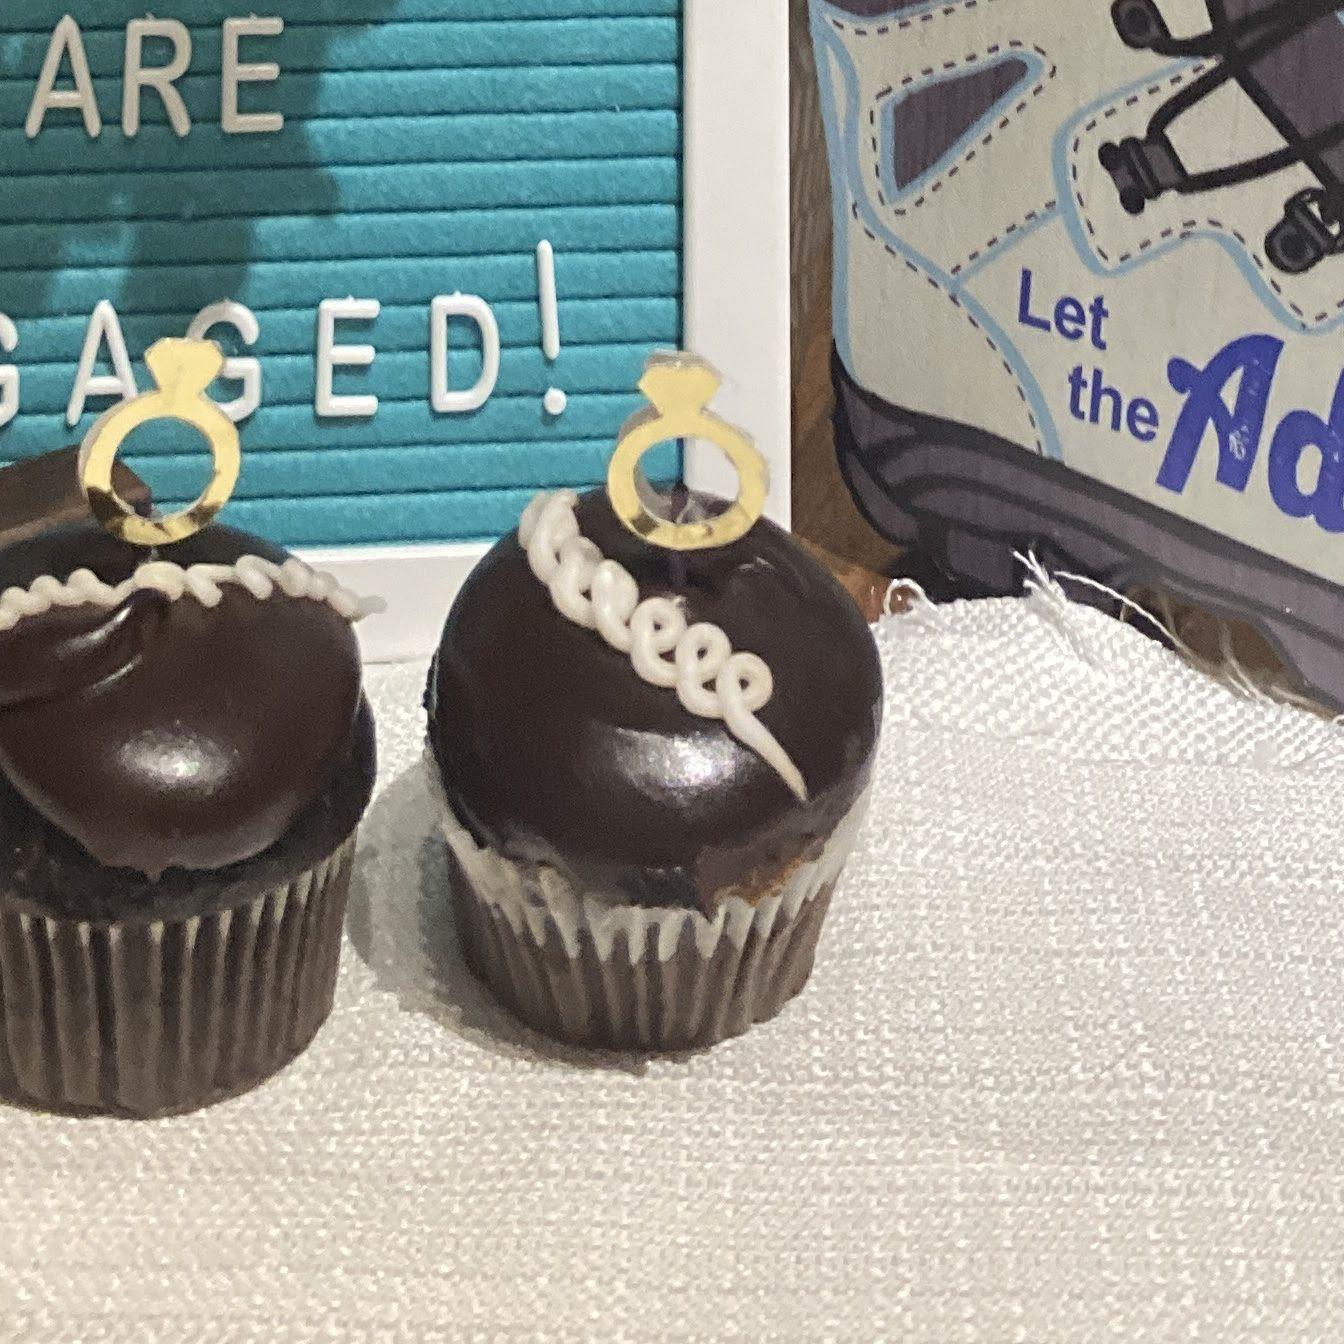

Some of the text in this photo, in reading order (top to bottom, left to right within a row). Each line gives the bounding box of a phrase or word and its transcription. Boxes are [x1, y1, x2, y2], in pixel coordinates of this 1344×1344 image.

[24, 14, 285, 138] ARE
[1017, 268, 1109, 352] Let
[1067, 362, 1160, 441] the
